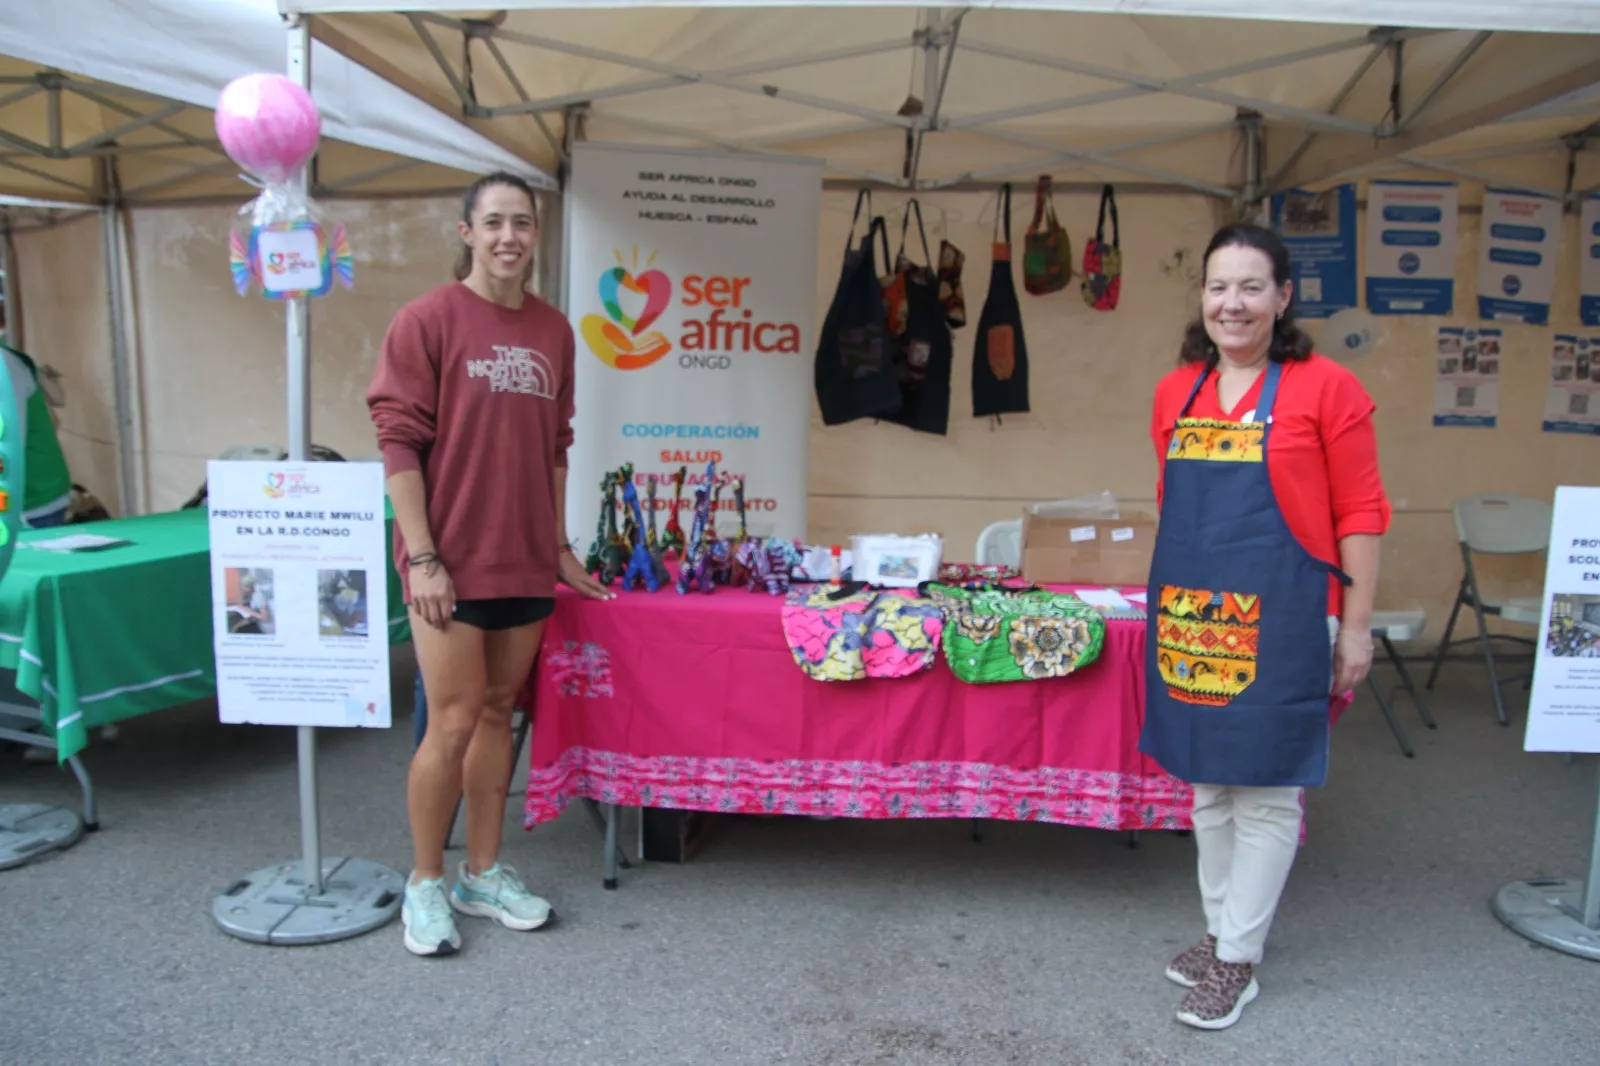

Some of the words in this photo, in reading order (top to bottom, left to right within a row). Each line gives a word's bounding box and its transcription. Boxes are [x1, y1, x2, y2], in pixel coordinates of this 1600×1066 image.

[638, 171, 664, 182] SER
[668, 173, 714, 185] AFRICA
[718, 176, 757, 188] ONGD
[622, 190, 667, 201] AYUDA
[671, 193, 686, 203] AL
[690, 194, 775, 208] DESARROLLO
[638, 211, 693, 222] HUESCA
[706, 213, 758, 226] ESPAÑA
[681, 275, 751, 307] ser
[679, 308, 800, 353] africa
[491, 345, 531, 361] THE
[467, 359, 532, 378] NORTH
[678, 354, 731, 370] ONGD
[490, 376, 533, 393] FACE
[622, 423, 760, 440] COOPERACIÓN
[660, 449, 723, 464] SALUD
[212, 509, 281, 520] PROYECTO
[284, 511, 326, 521] MARIE
[330, 512, 374, 521] MWILU
[236, 526, 253, 535] EN
[258, 526, 273, 536] LA
